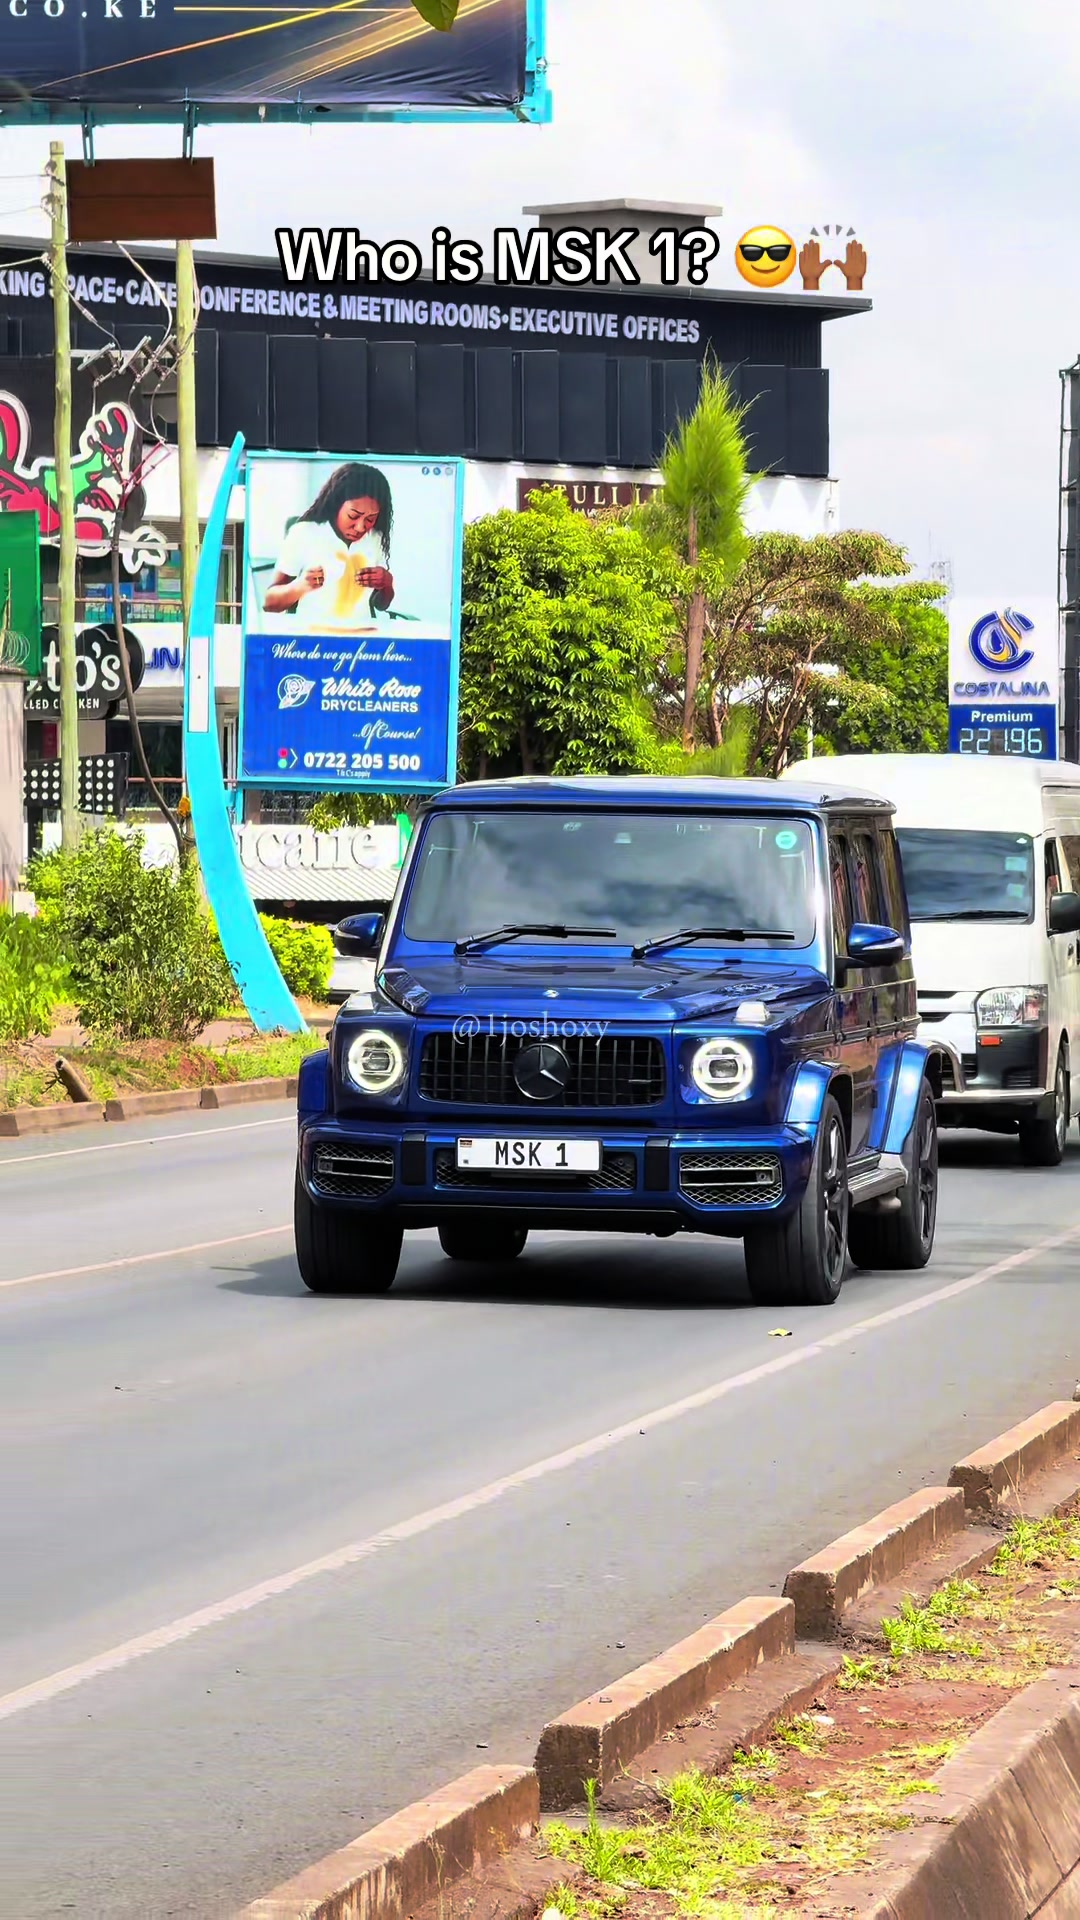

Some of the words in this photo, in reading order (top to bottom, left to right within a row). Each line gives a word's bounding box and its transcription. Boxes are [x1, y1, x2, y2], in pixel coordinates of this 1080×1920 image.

[48, 276, 117, 304] PACE
[200, 285, 320, 318] ONFERENCE
[340, 294, 428, 326] MEETING
[431, 300, 501, 330] ROOMS
[509, 306, 618, 338] EXECUTIVE
[622, 315, 700, 344] OFFICES
[271, 639, 306, 659] Where
[307, 643, 320, 660] do
[322, 650, 338, 660] we
[332, 651, 353, 672] go
[348, 641, 381, 673] from
[321, 677, 376, 697] White
[378, 676, 422, 698] Rose
[953, 681, 1051, 697] COSTALINA
[321, 699, 419, 713] DRYCLEANERS
[971, 710, 1033, 723] Premium
[376, 721, 422, 739] Course!
[303, 752, 347, 768] 0722
[351, 753, 384, 769] 205
[388, 754, 421, 771] 500
[494, 1141, 542, 1167] MSK
[555, 1142, 569, 1167] 1
